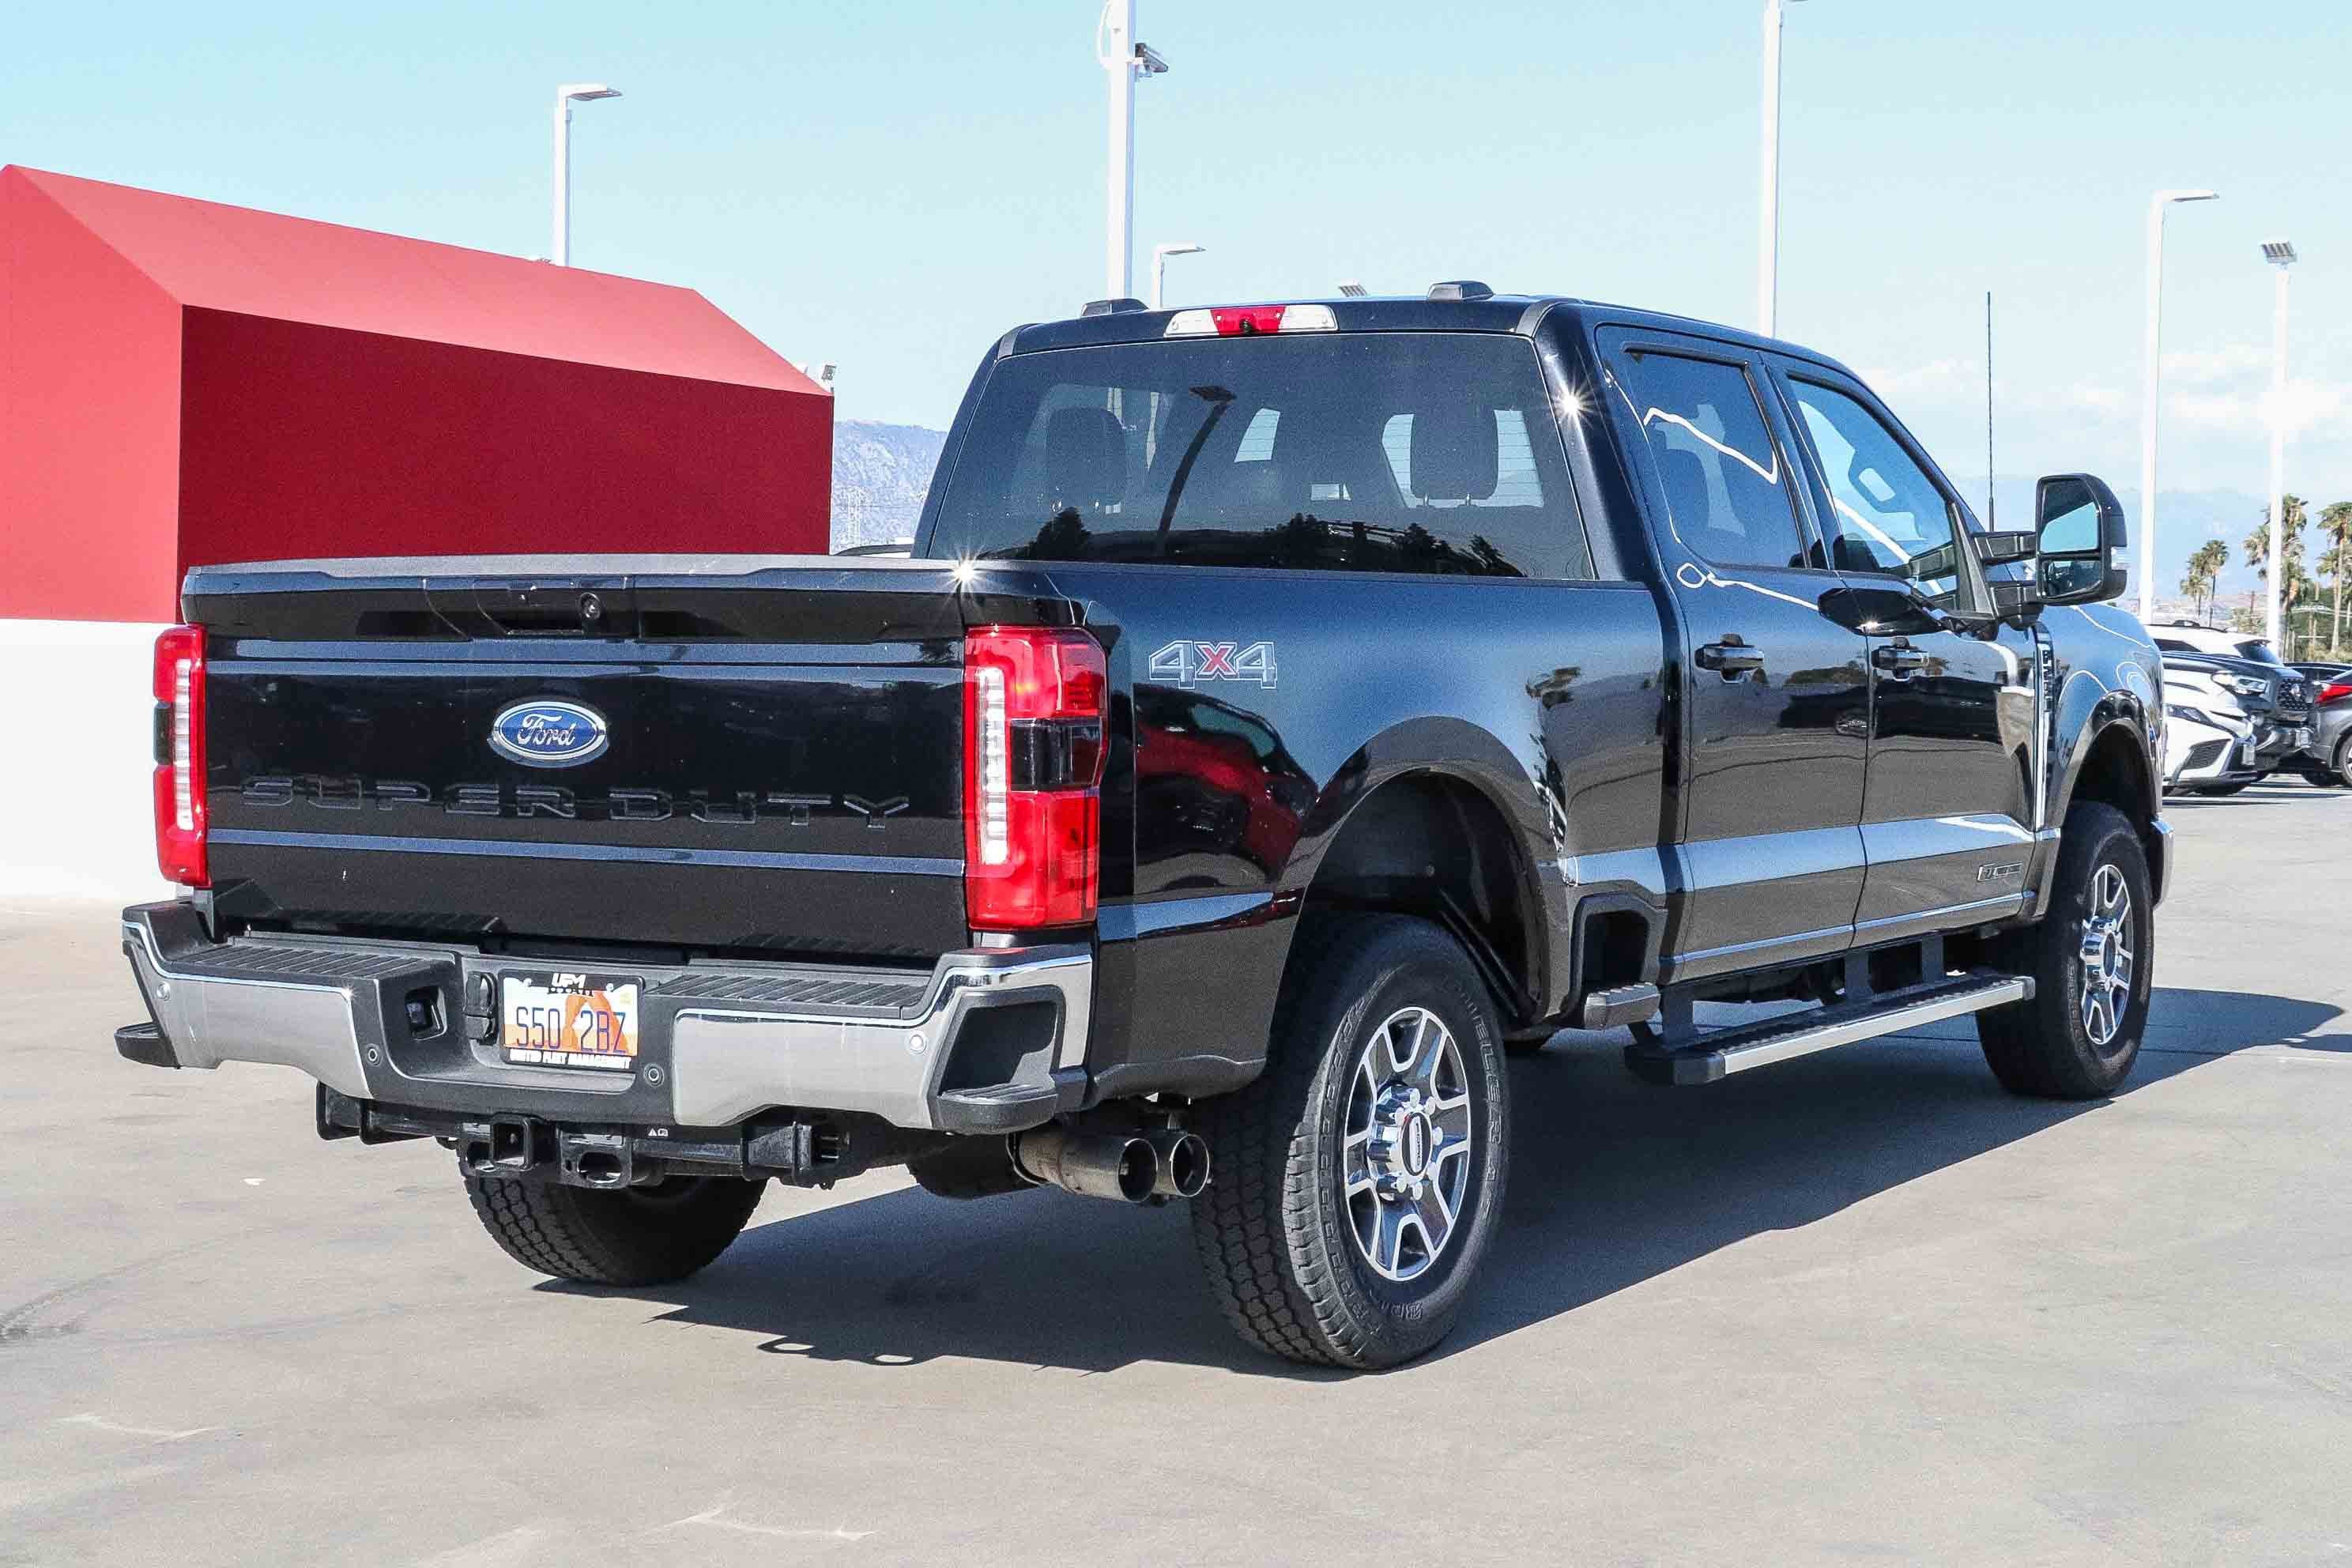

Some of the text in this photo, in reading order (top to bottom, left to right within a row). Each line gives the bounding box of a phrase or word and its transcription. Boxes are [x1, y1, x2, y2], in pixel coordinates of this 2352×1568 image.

[517, 713, 578, 746] Ford
[241, 775, 910, 830] SUPER DUTY
[515, 1006, 561, 1050] S50
